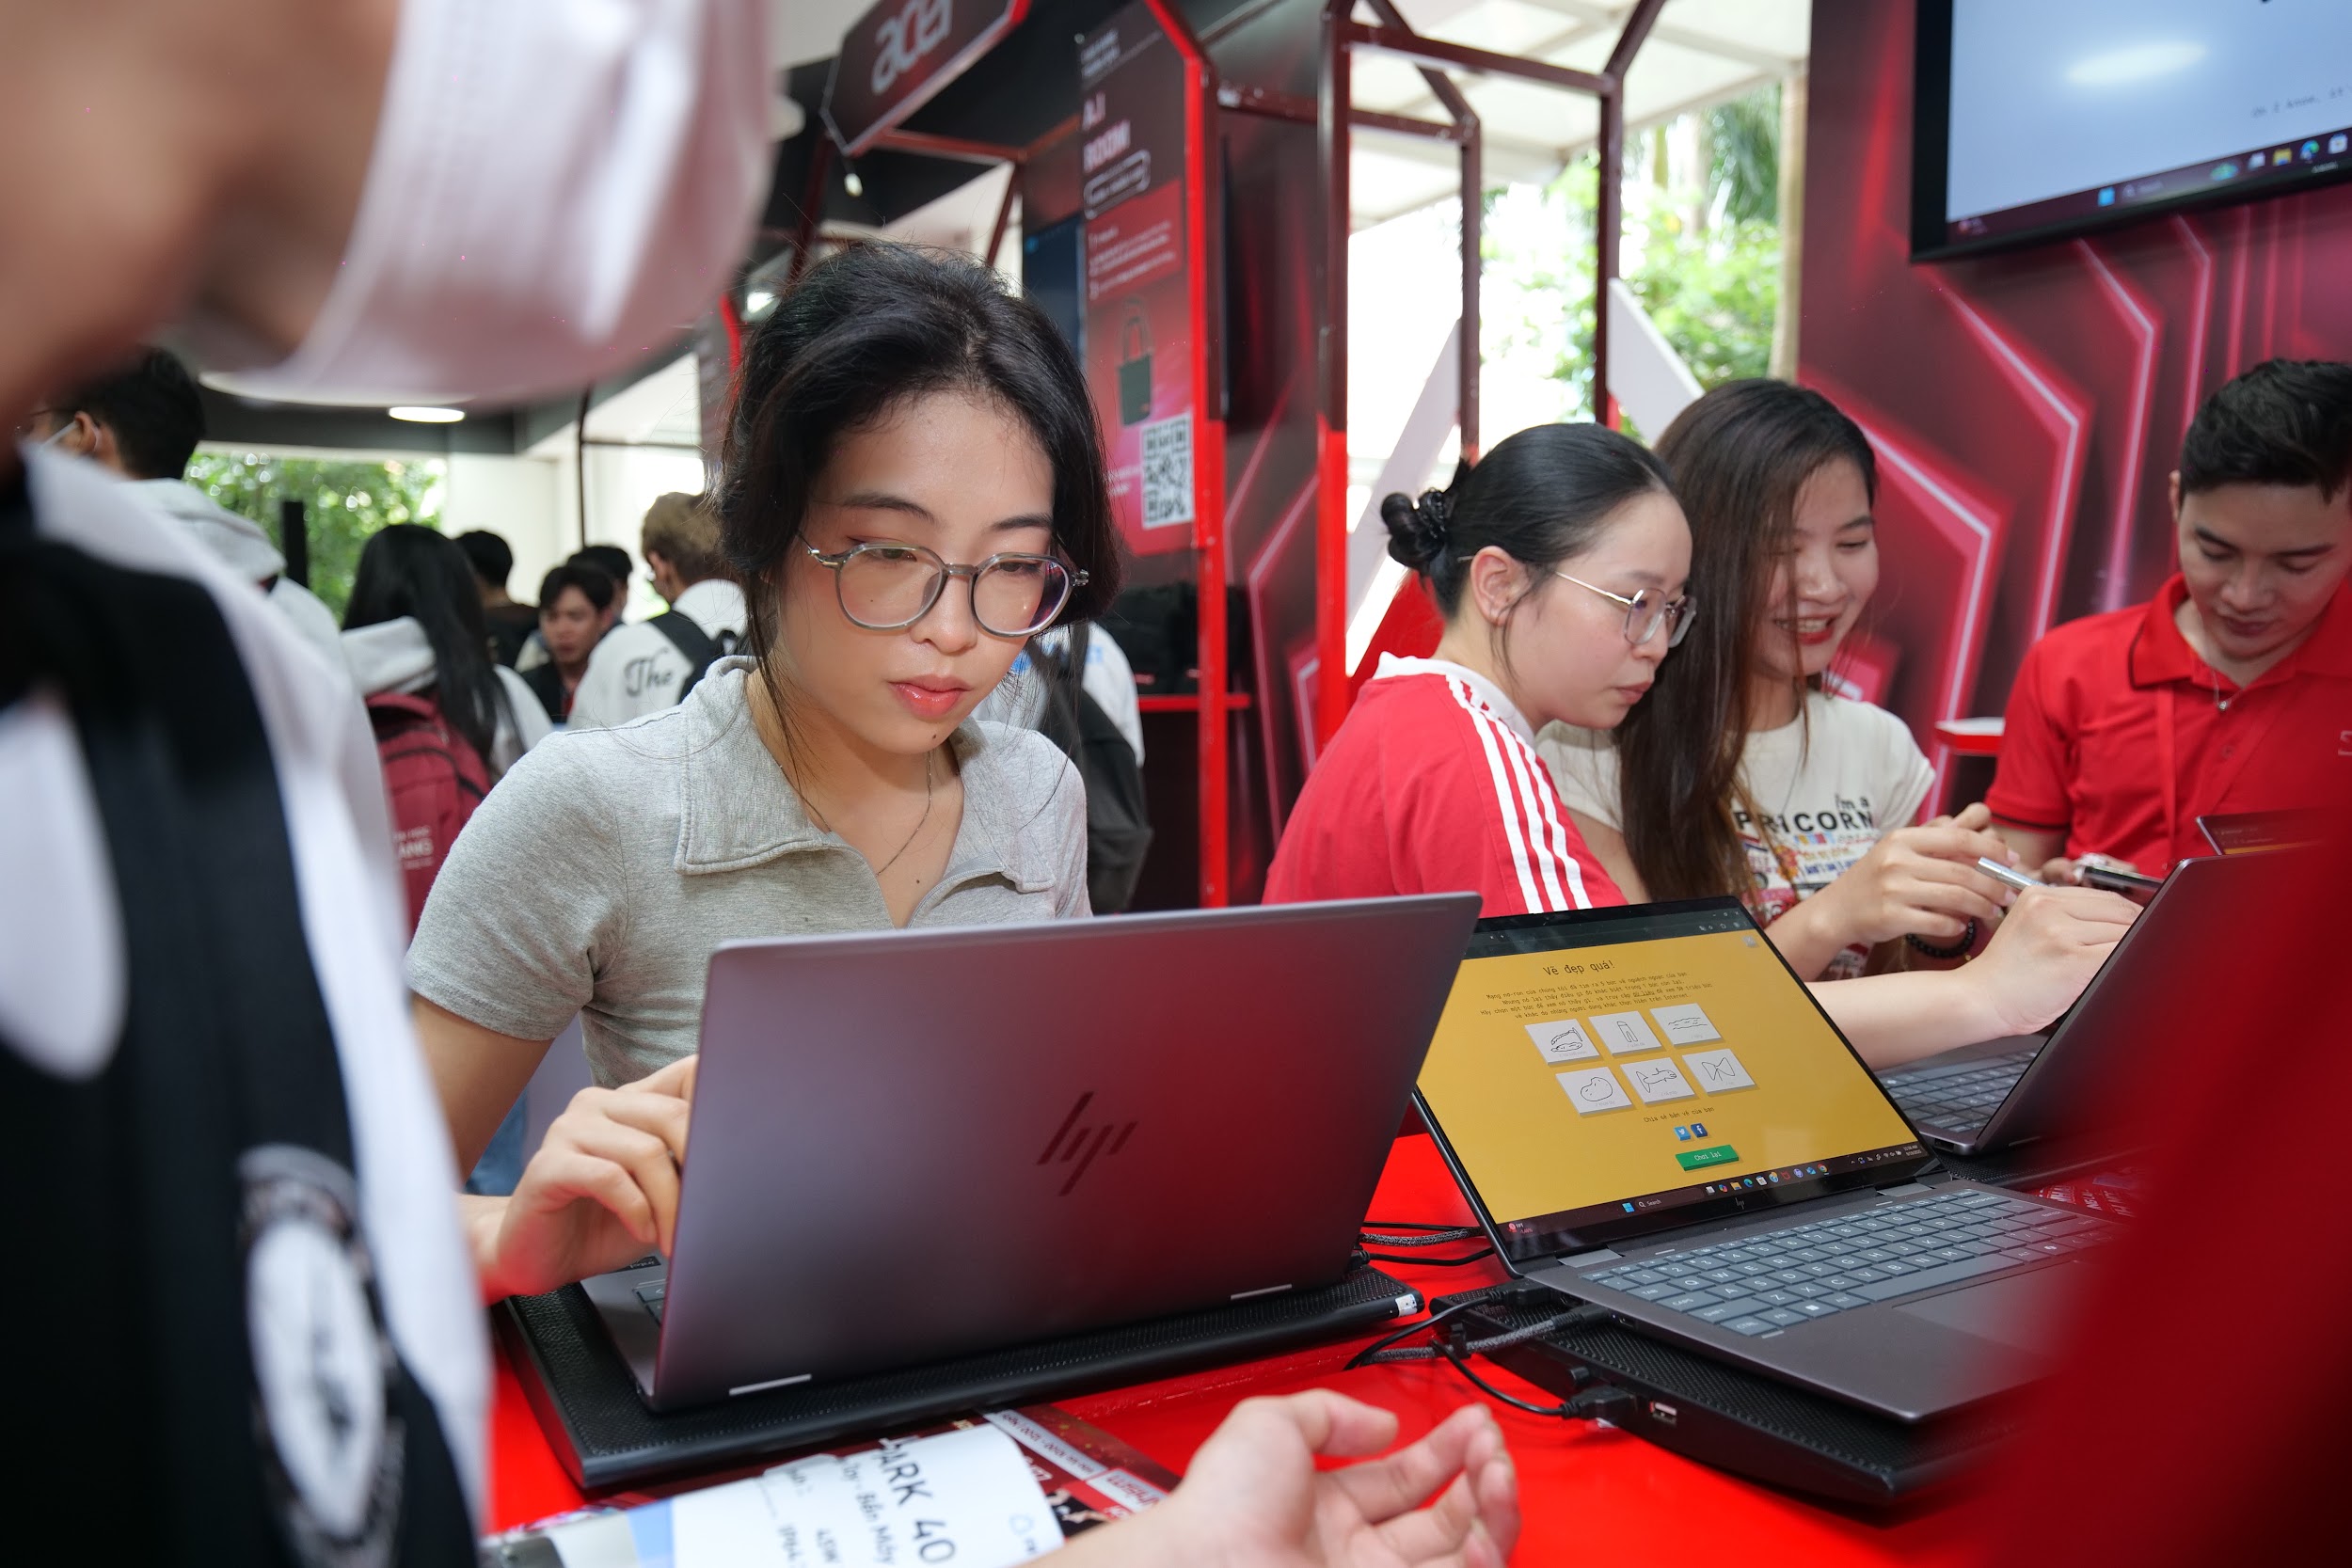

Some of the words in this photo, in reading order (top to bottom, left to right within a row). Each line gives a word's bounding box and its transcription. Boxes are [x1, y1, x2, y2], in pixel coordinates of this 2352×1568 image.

[624, 647, 673, 697] The
[1734, 811, 1873, 833] PRICORN
[1543, 966, 1560, 975] Vẽ
[1564, 965, 1585, 975] đẹp
[1590, 960, 1615, 973] quá!
[1037, 1091, 1138, 1196] hp
[1646, 1198, 1662, 1208] Search
[913, 1519, 957, 1564] 40
